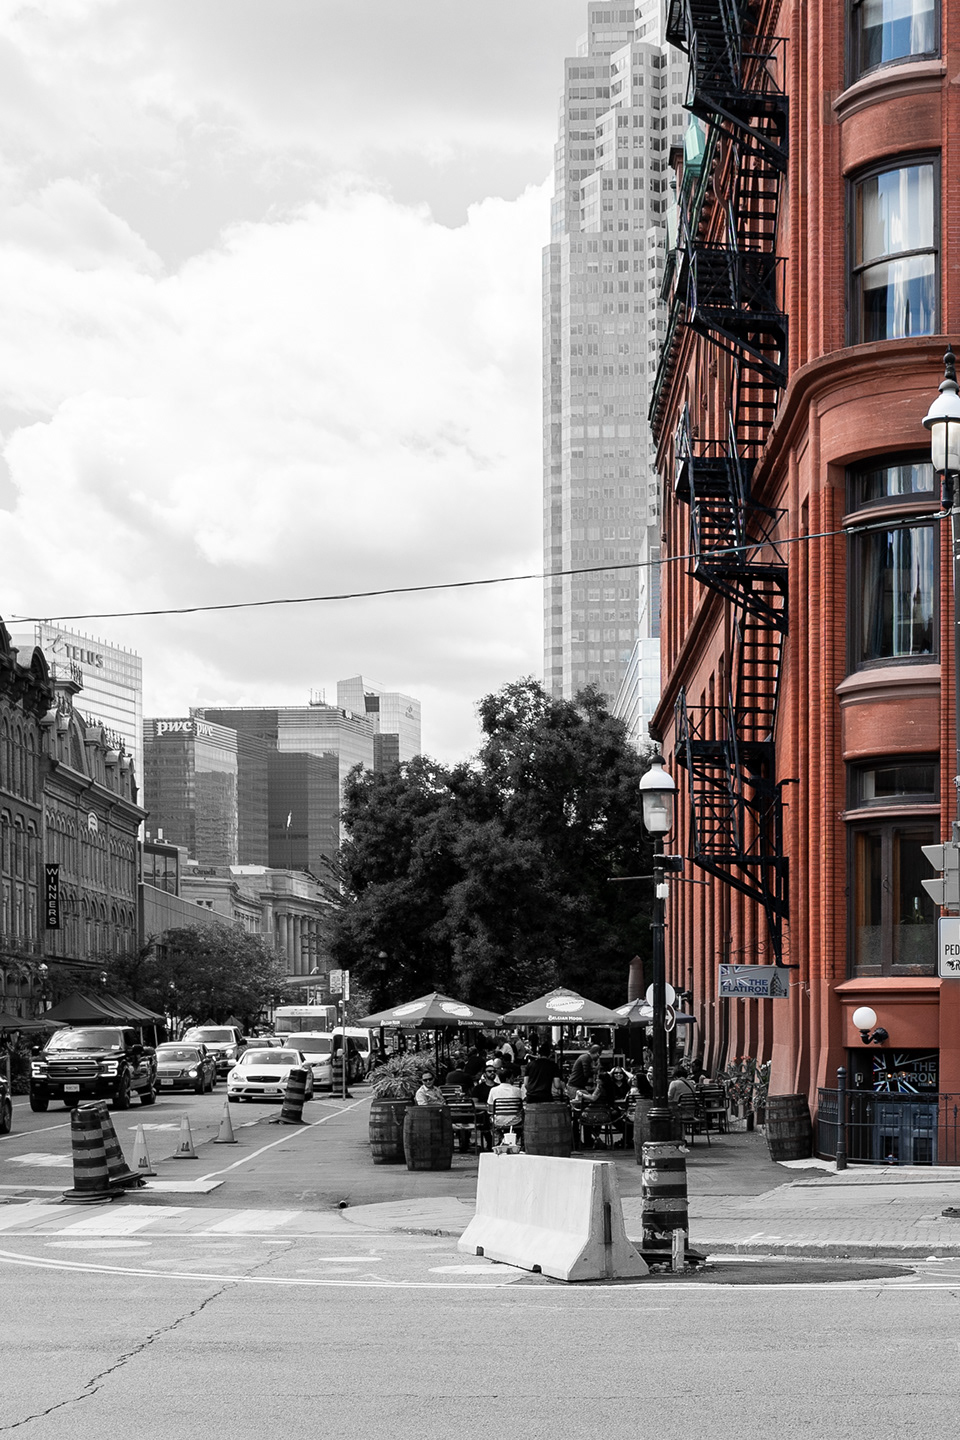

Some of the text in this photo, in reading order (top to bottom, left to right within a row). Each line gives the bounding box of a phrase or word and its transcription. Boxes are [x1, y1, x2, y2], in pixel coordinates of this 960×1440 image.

[65, 643, 103, 668] TELUS
[156, 721, 192, 736] pwc
[196, 722, 213, 737] pwc
[46, 868, 59, 925] WINNERS
[912, 1062, 936, 1071] THE
